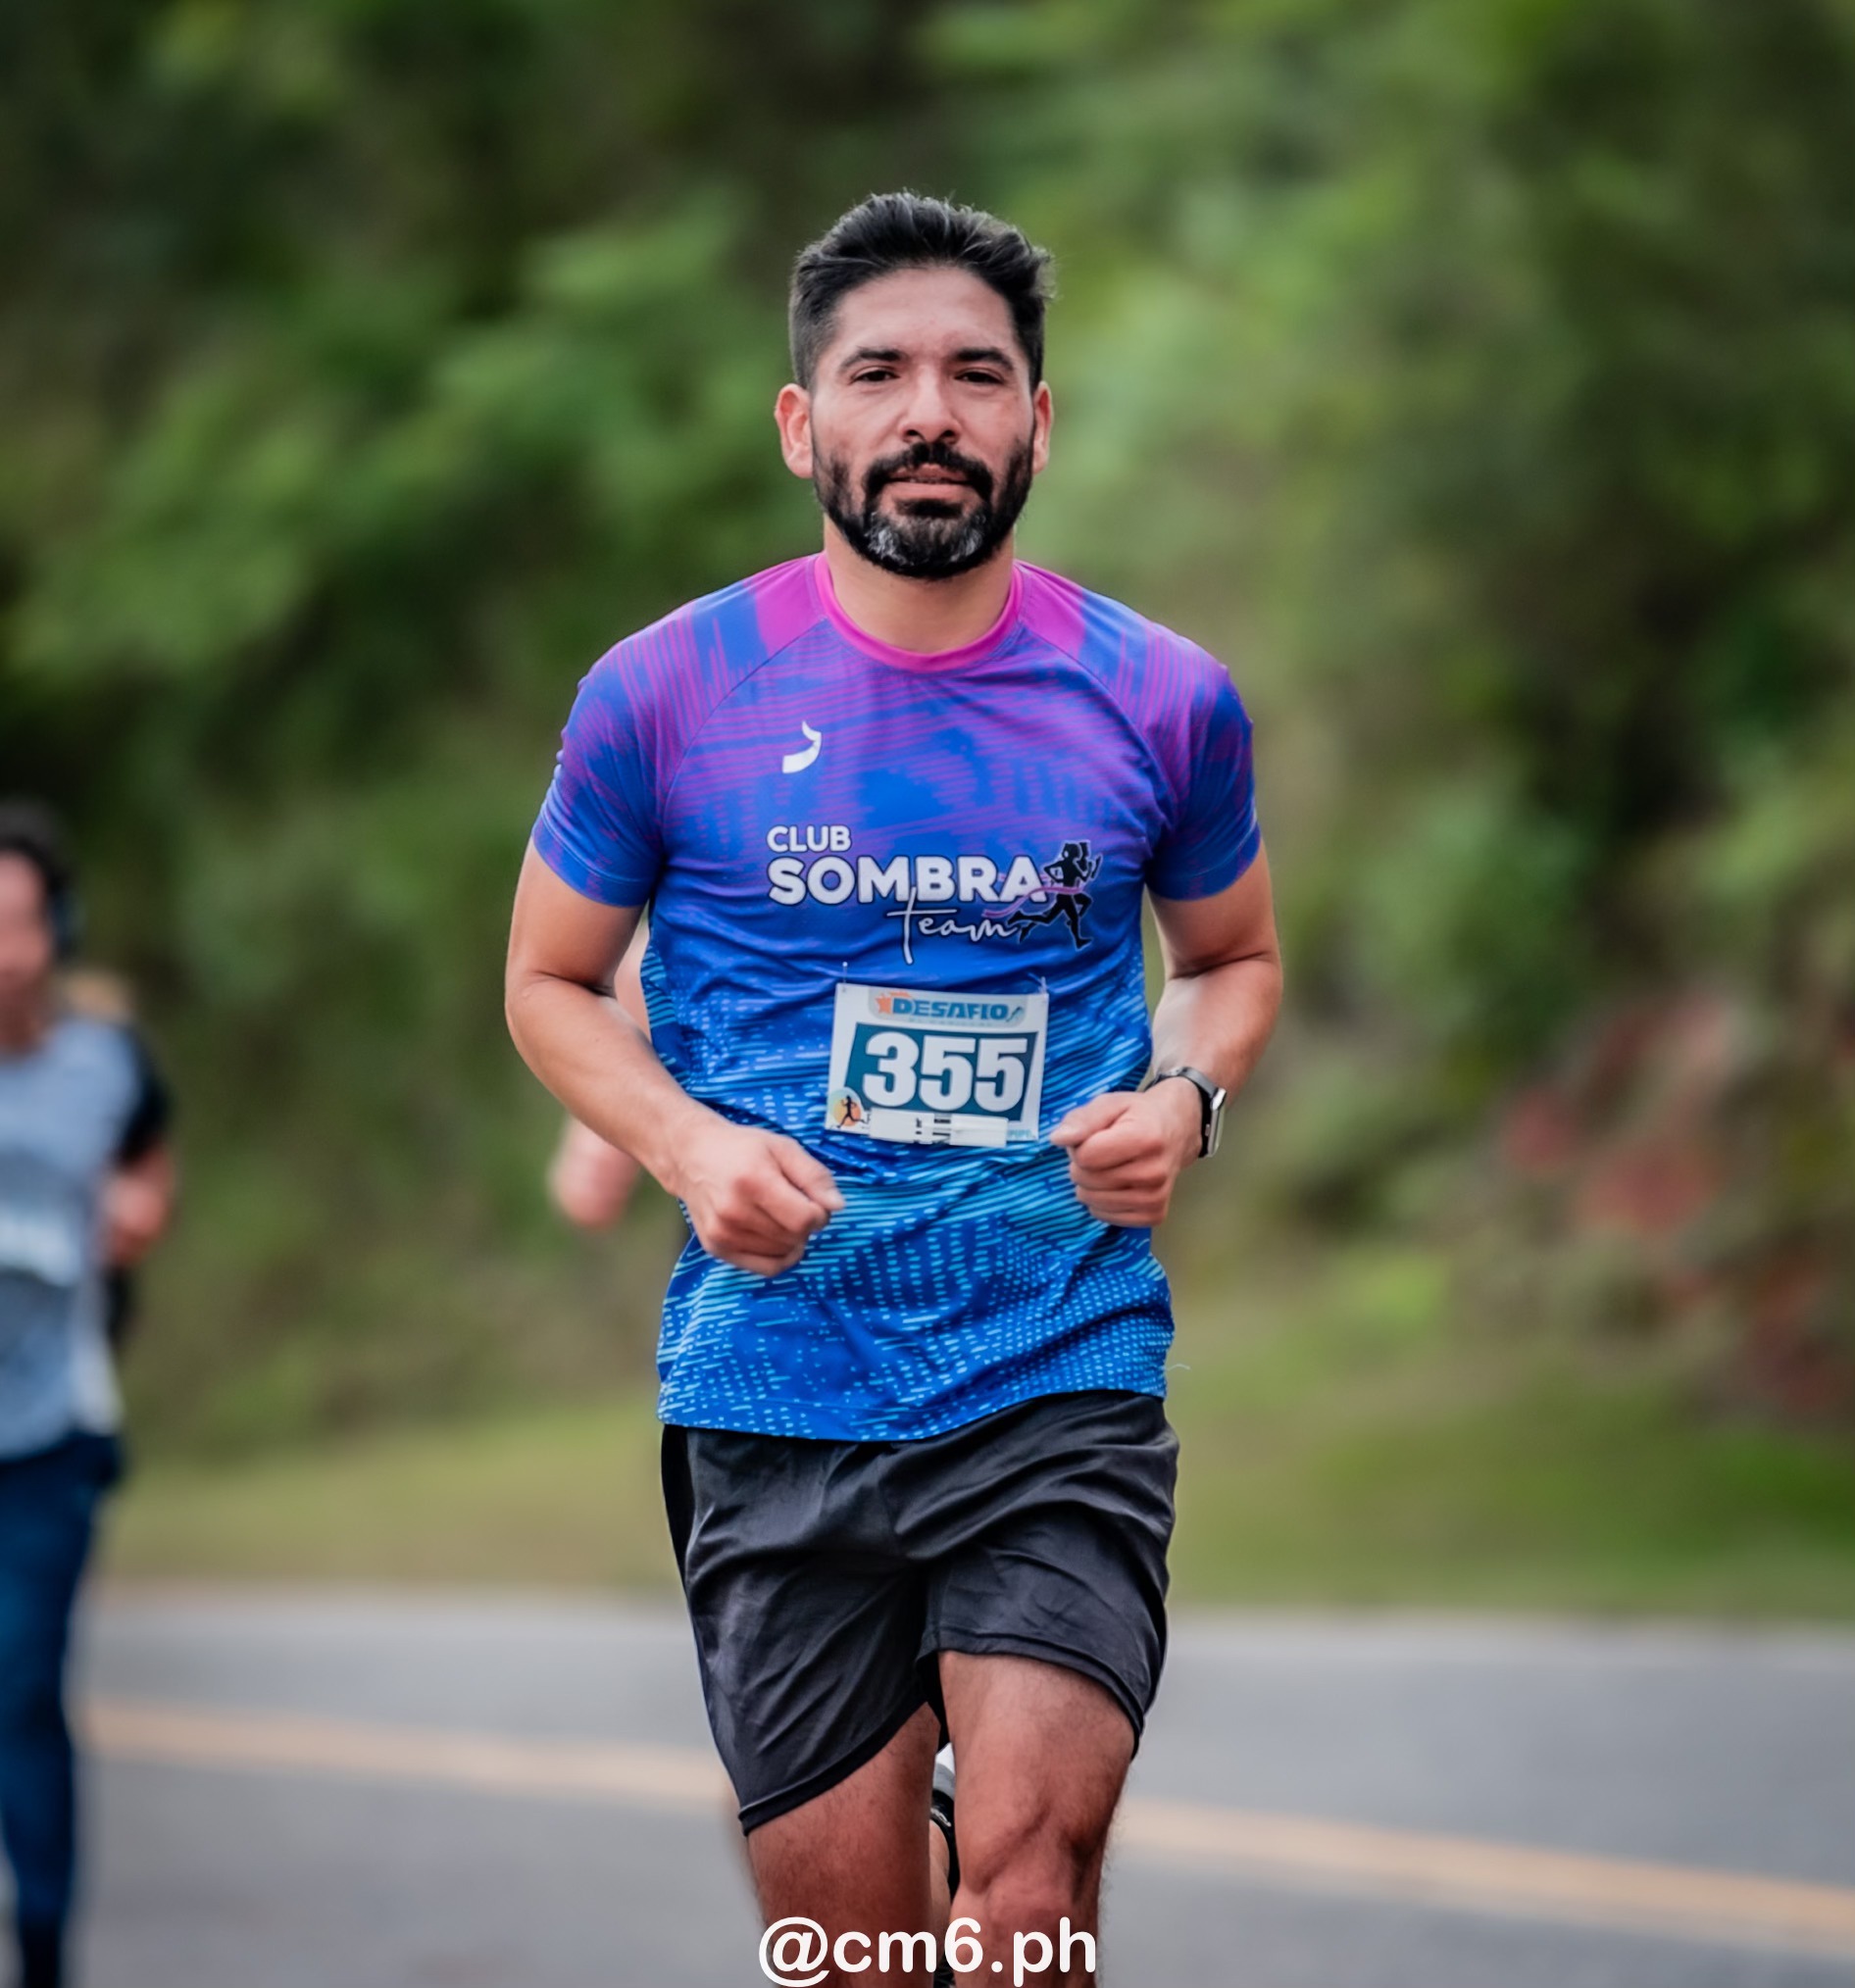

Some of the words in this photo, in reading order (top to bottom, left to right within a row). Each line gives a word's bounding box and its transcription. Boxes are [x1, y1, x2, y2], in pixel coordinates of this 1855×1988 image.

[767, 824, 851, 853] CLUB
[768, 856, 1046, 905] SOMBRA
[892, 997, 1009, 1020] DESAFIO
[862, 1031, 1028, 1113] 355
